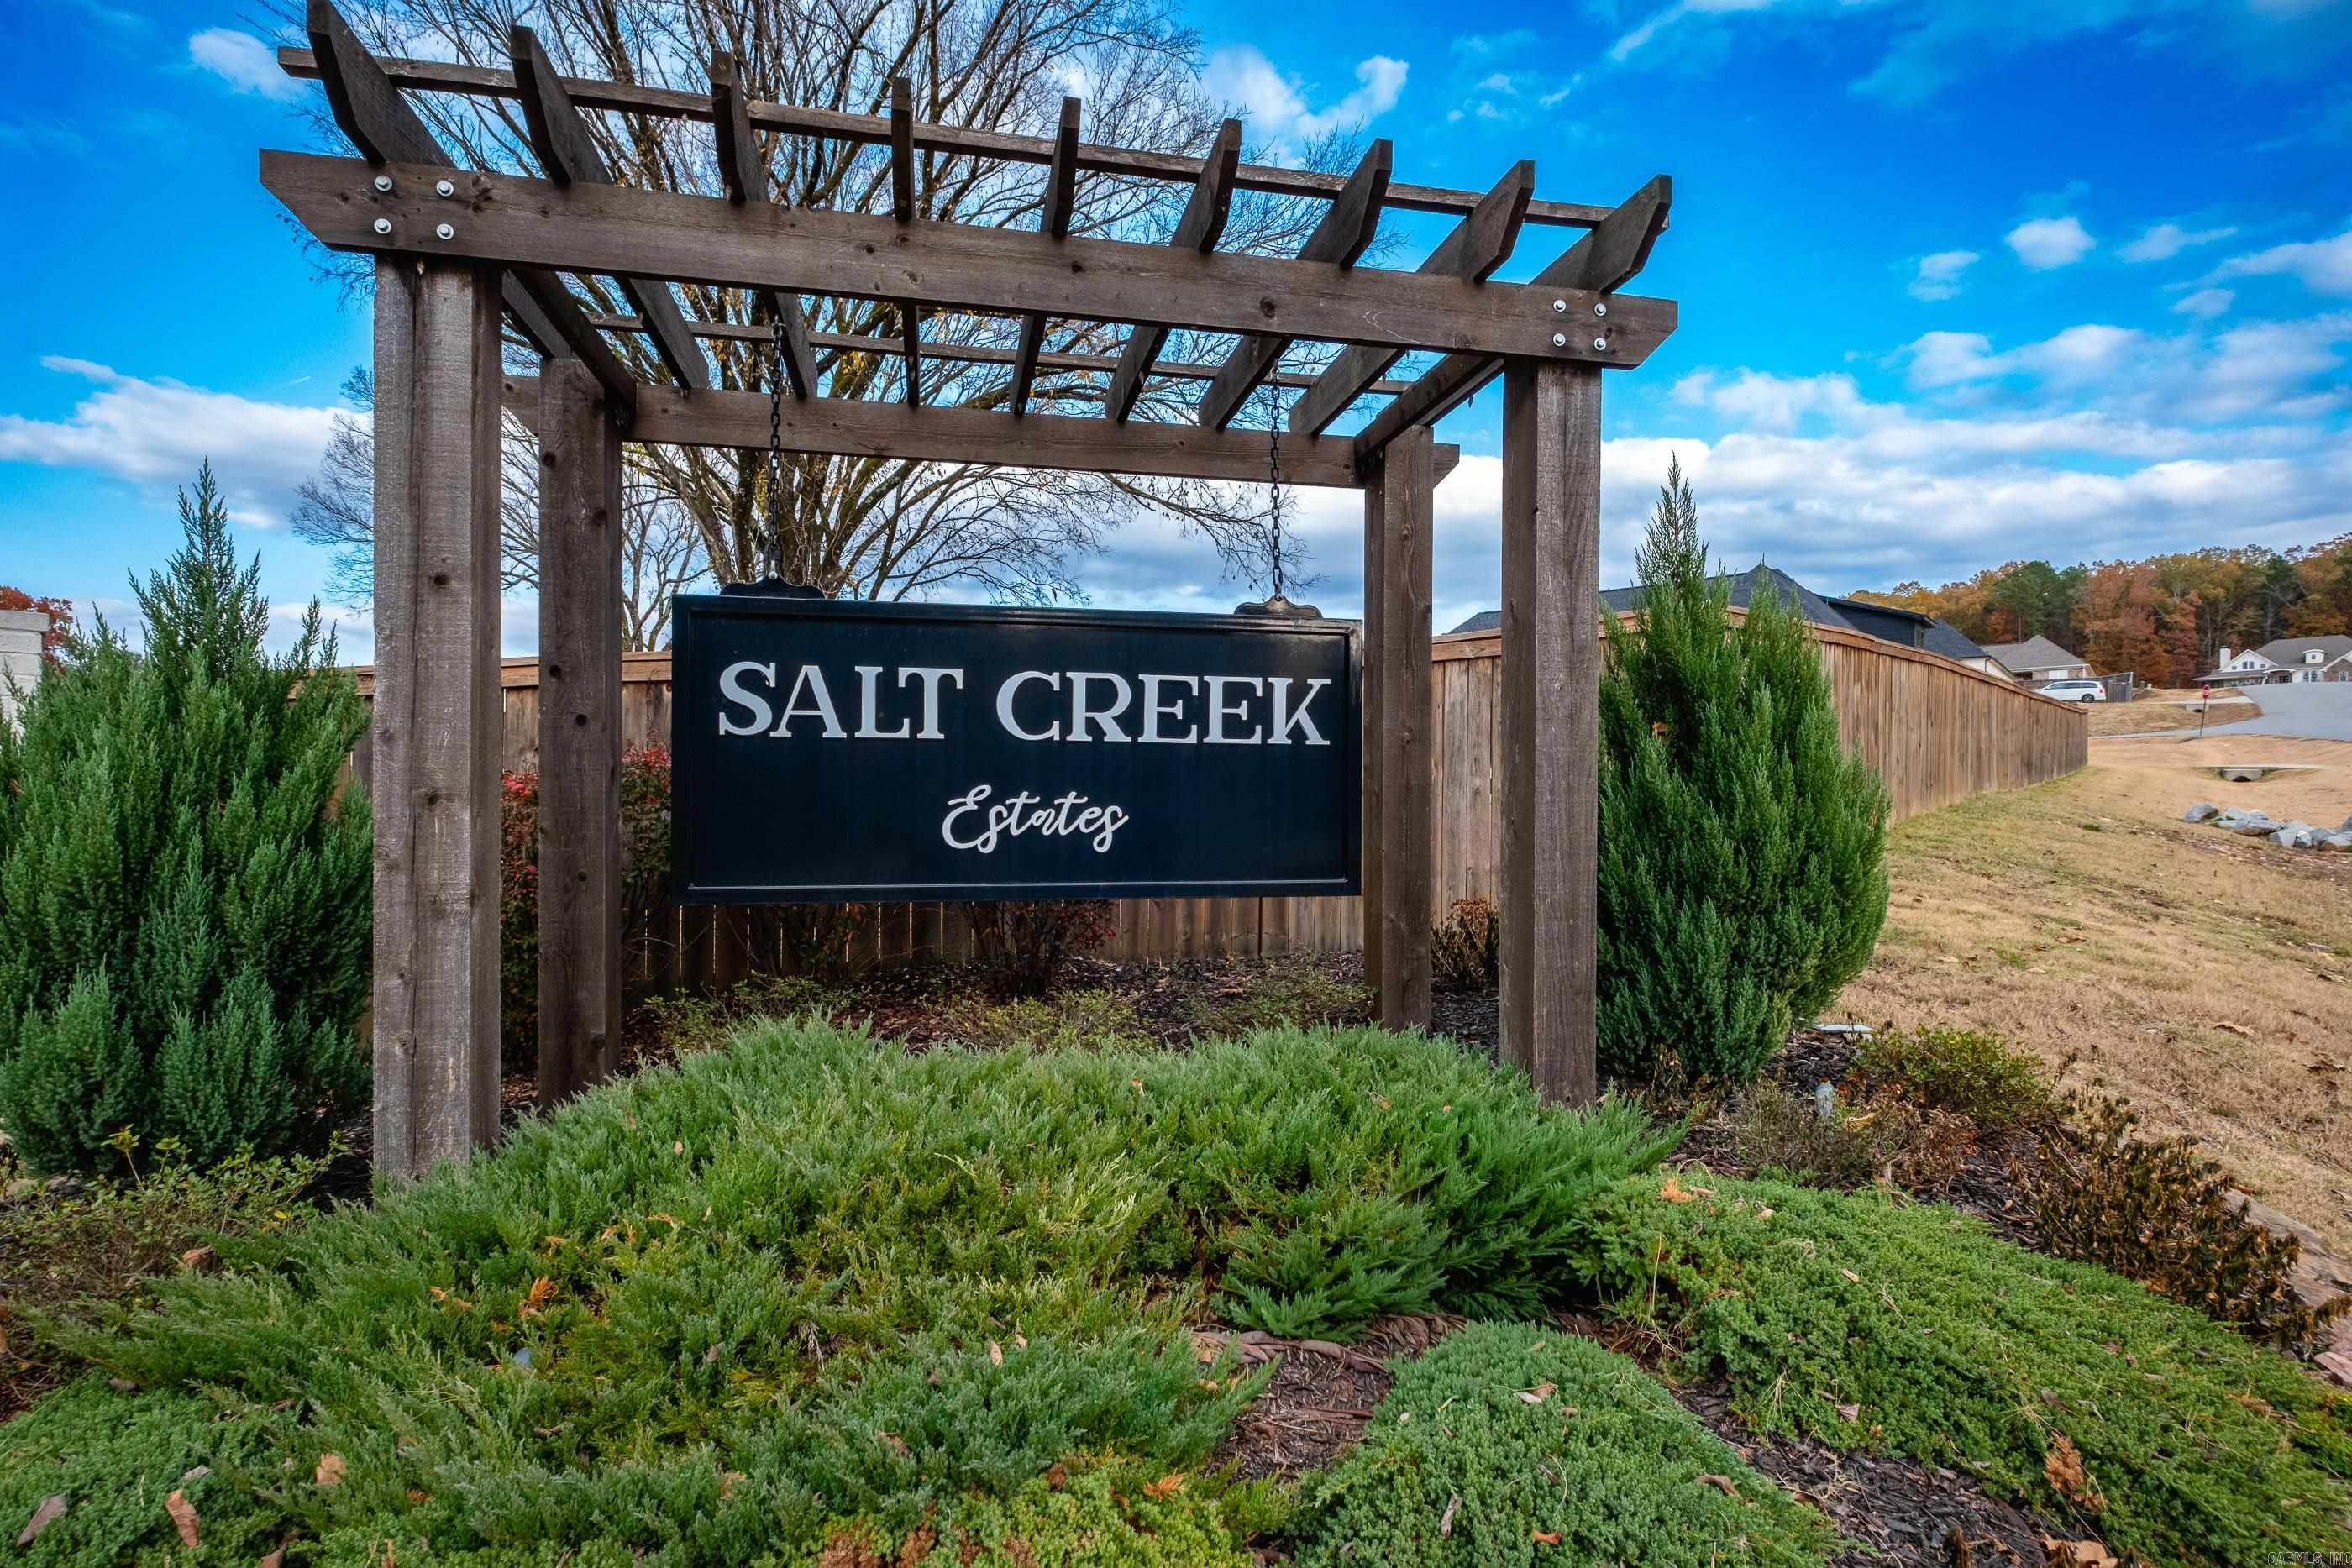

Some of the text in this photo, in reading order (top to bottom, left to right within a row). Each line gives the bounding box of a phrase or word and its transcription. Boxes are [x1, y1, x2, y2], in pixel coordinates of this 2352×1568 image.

[719, 661, 1331, 745] SALT CREEK
[942, 784, 1130, 854] Estates
